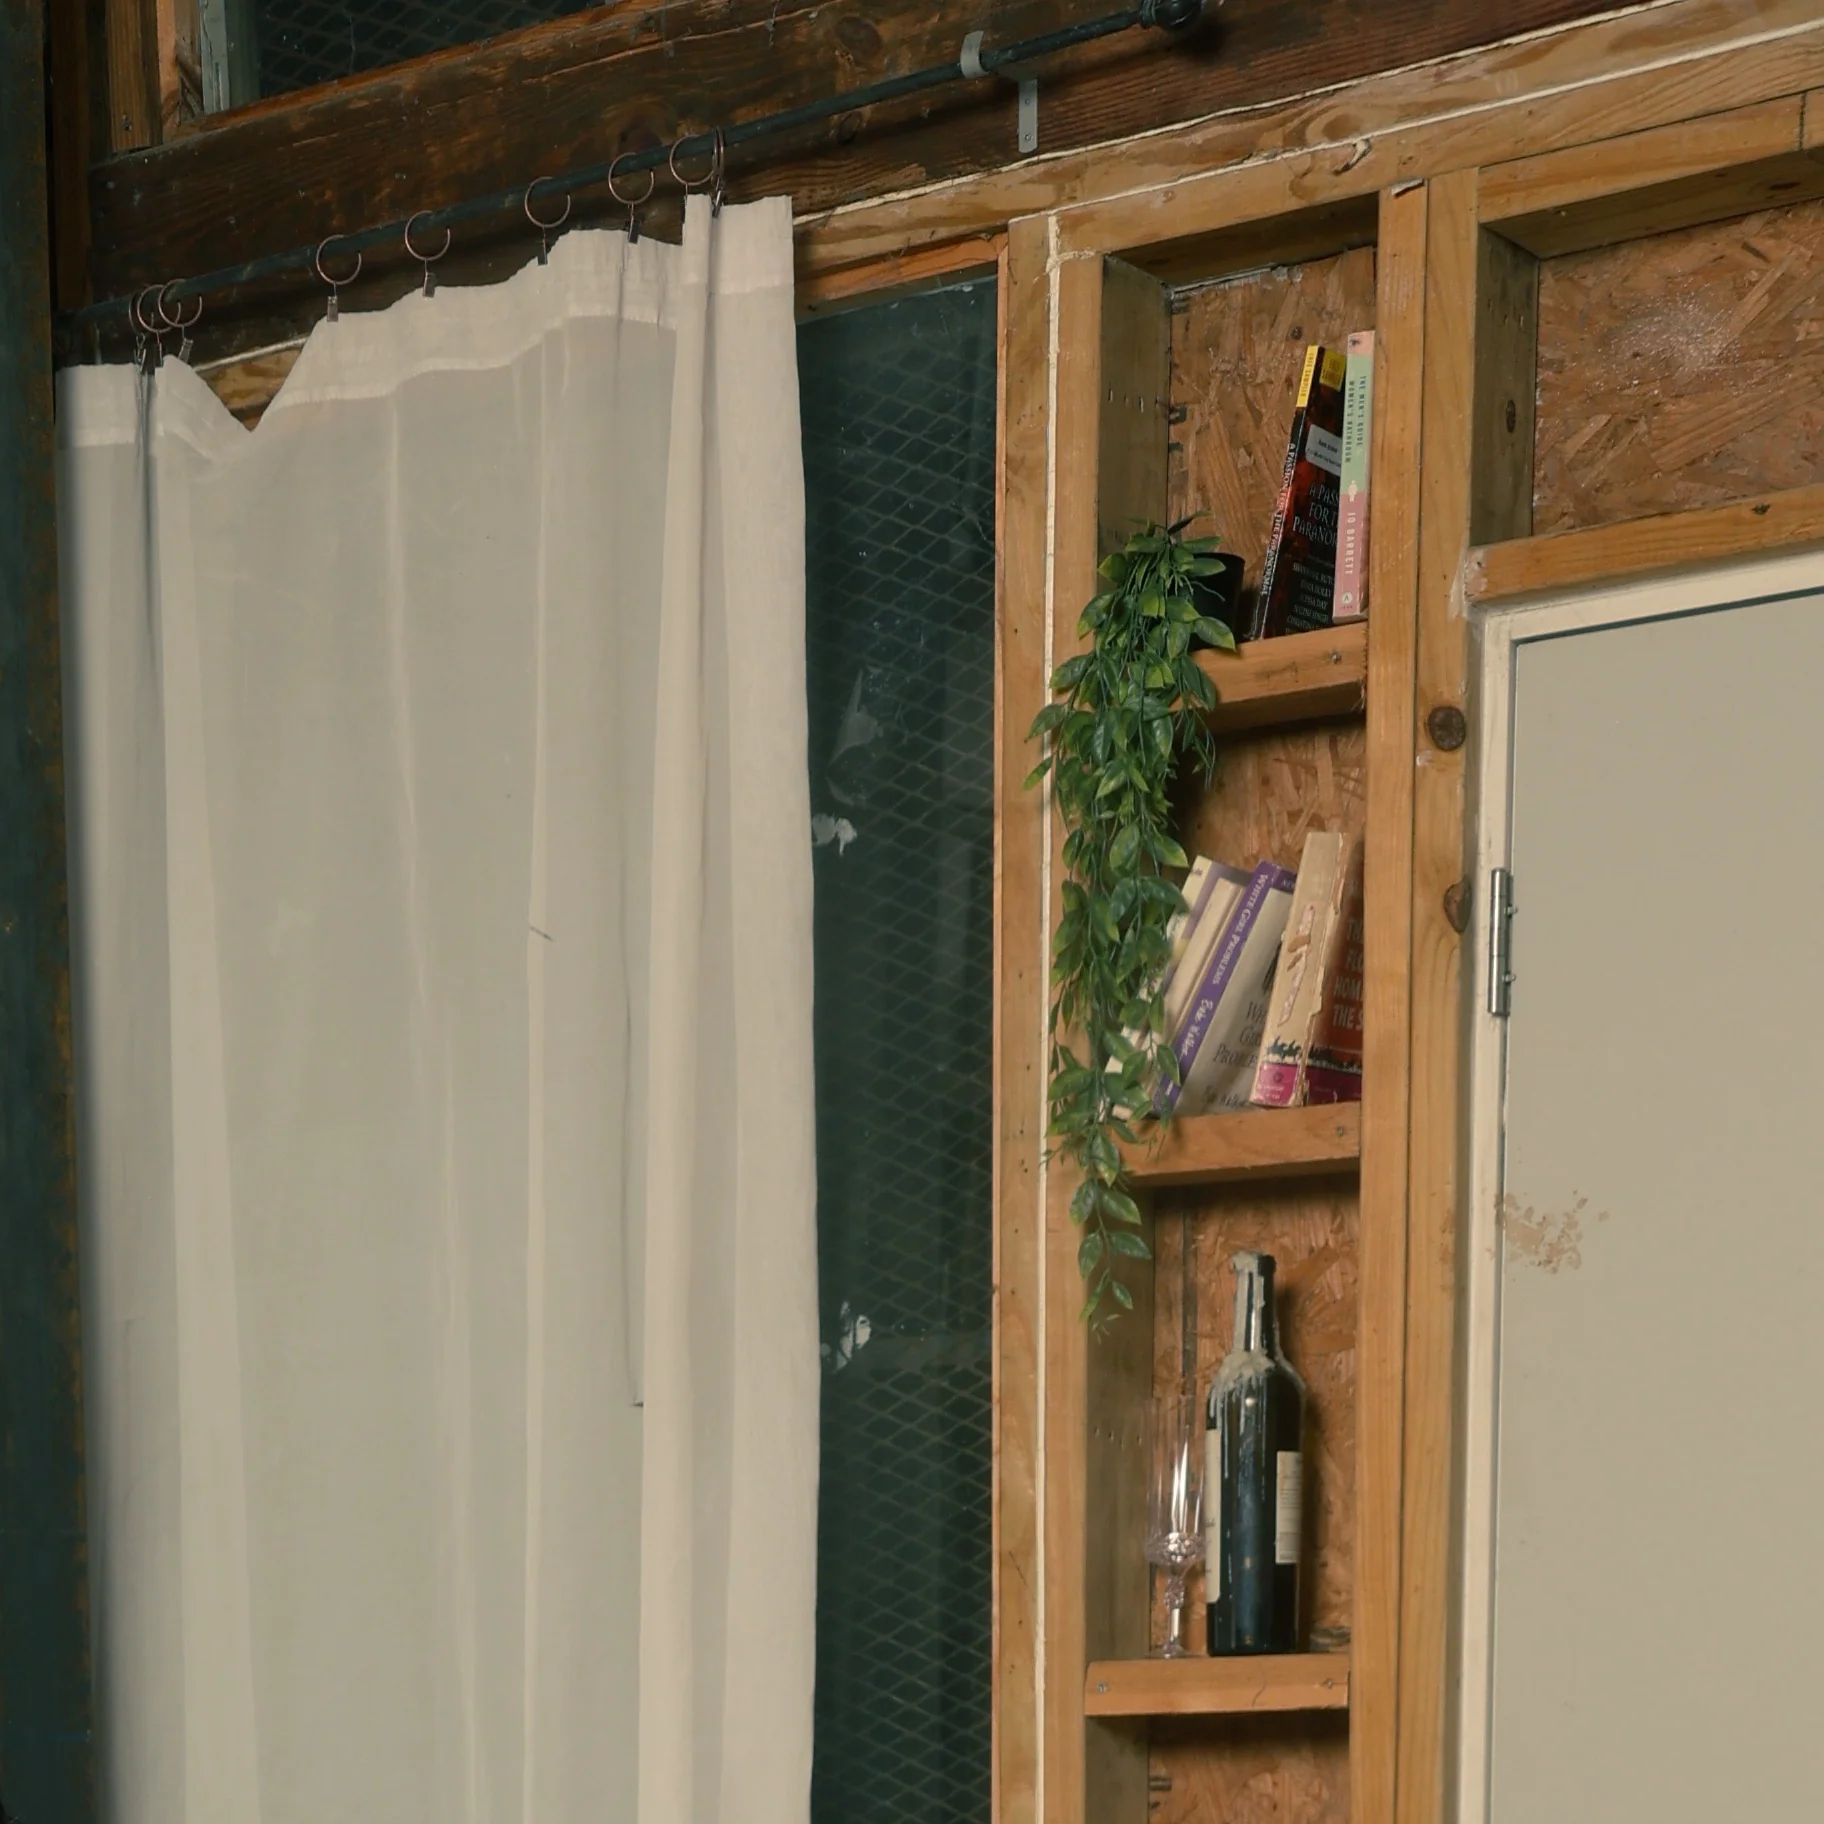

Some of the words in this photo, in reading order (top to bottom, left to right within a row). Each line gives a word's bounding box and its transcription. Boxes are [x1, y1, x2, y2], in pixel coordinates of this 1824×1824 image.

[1280, 451, 1295, 490] PASSION
[1310, 482, 1316, 497] A
[1309, 502, 1329, 526] FOR
[1260, 534, 1280, 596] PARANORMAL
[1344, 528, 1356, 575] BARRETT
[1212, 933, 1241, 985] PROBLEMS
[1332, 1004, 1355, 1029] THE
